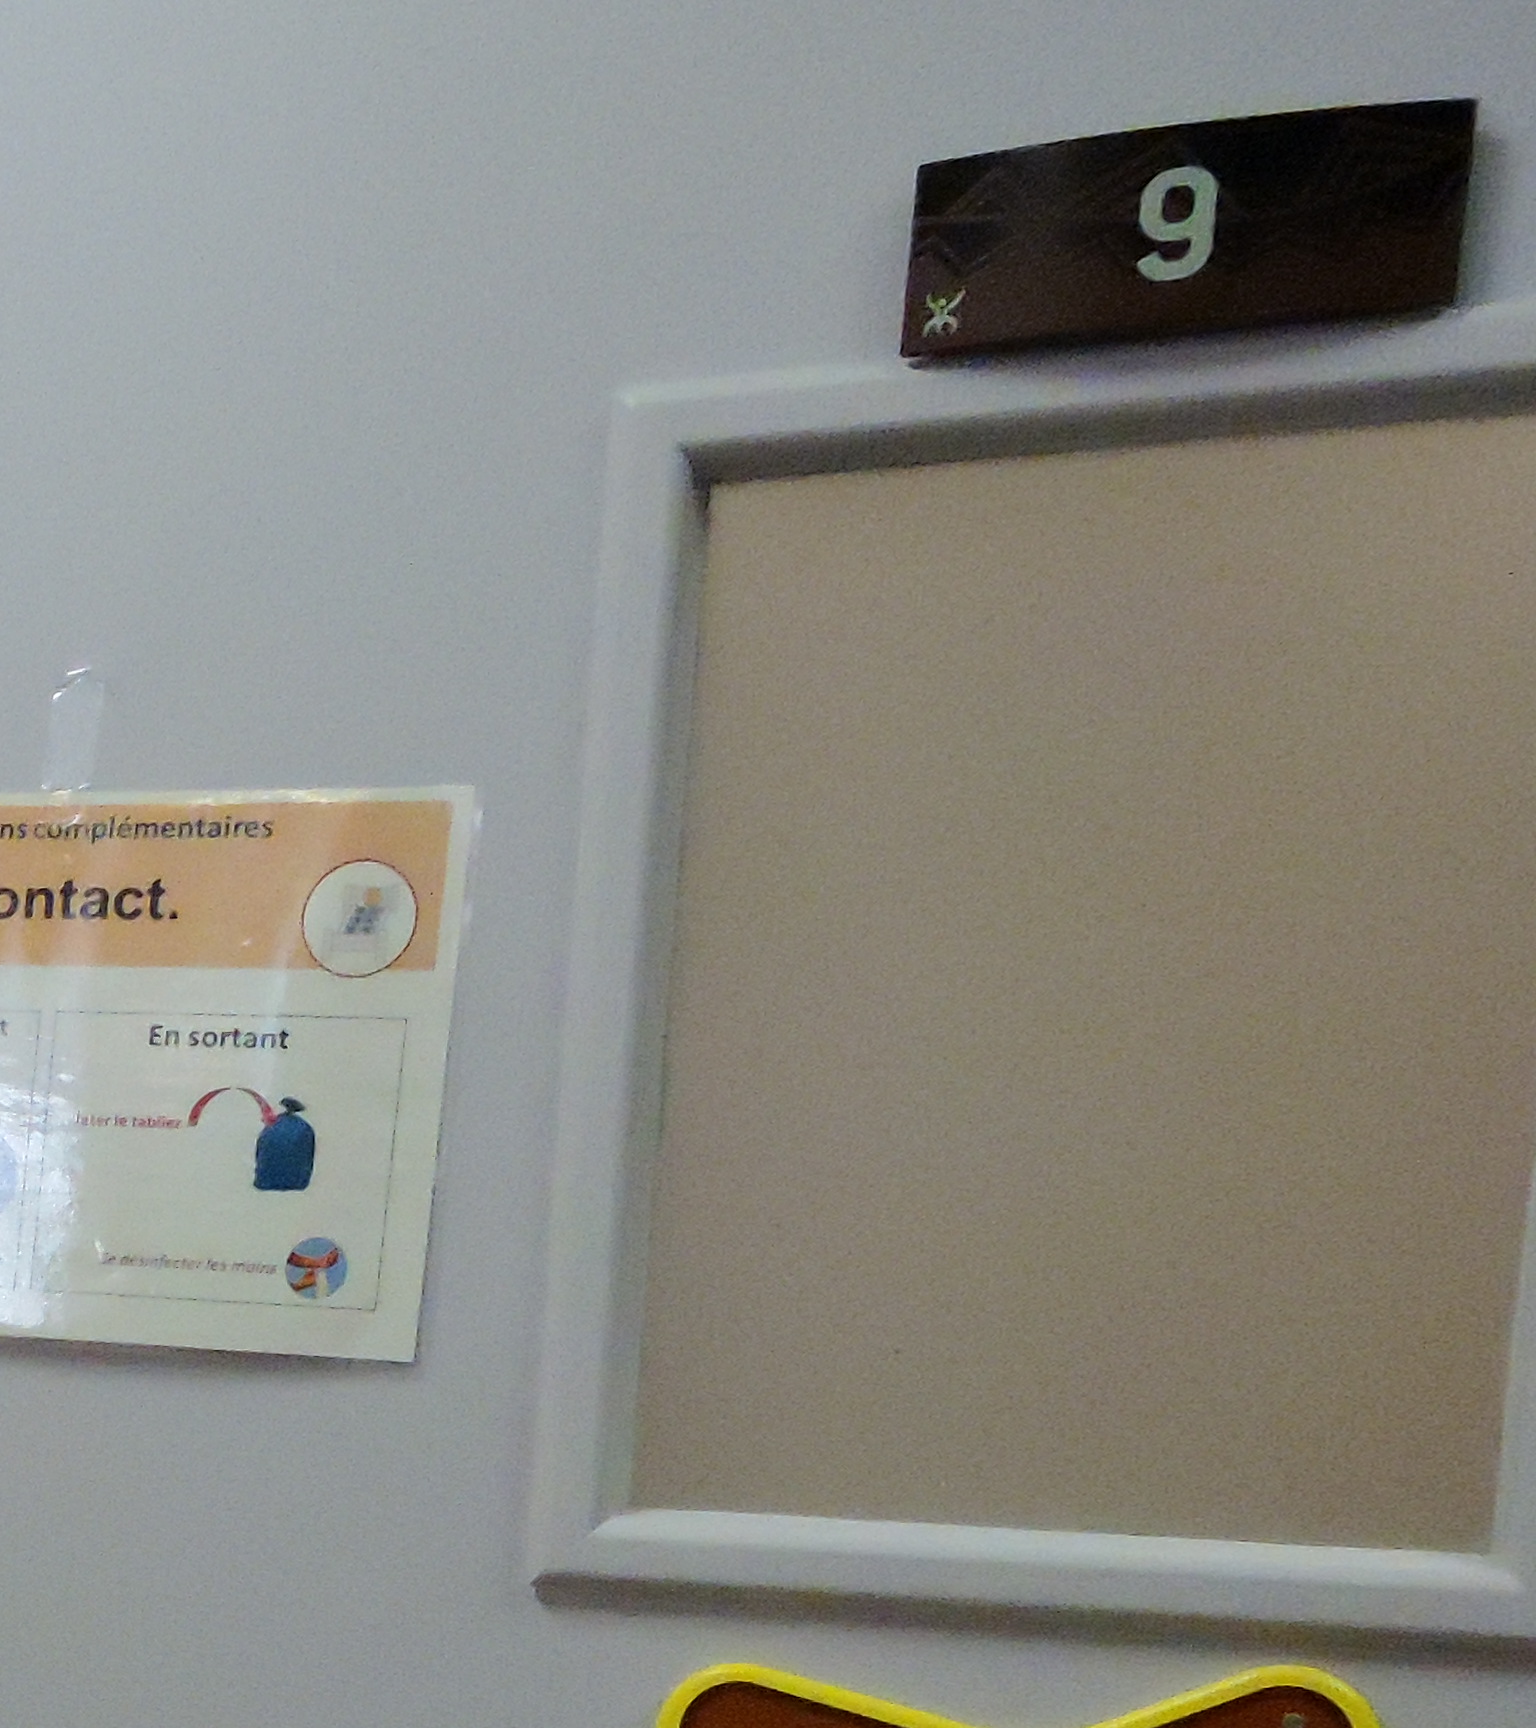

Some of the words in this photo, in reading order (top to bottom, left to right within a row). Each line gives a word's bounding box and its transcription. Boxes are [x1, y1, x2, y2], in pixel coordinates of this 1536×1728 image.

[1137, 165, 1219, 282] 9
[149, 1024, 178, 1046] En
[189, 1027, 289, 1050] sortant
